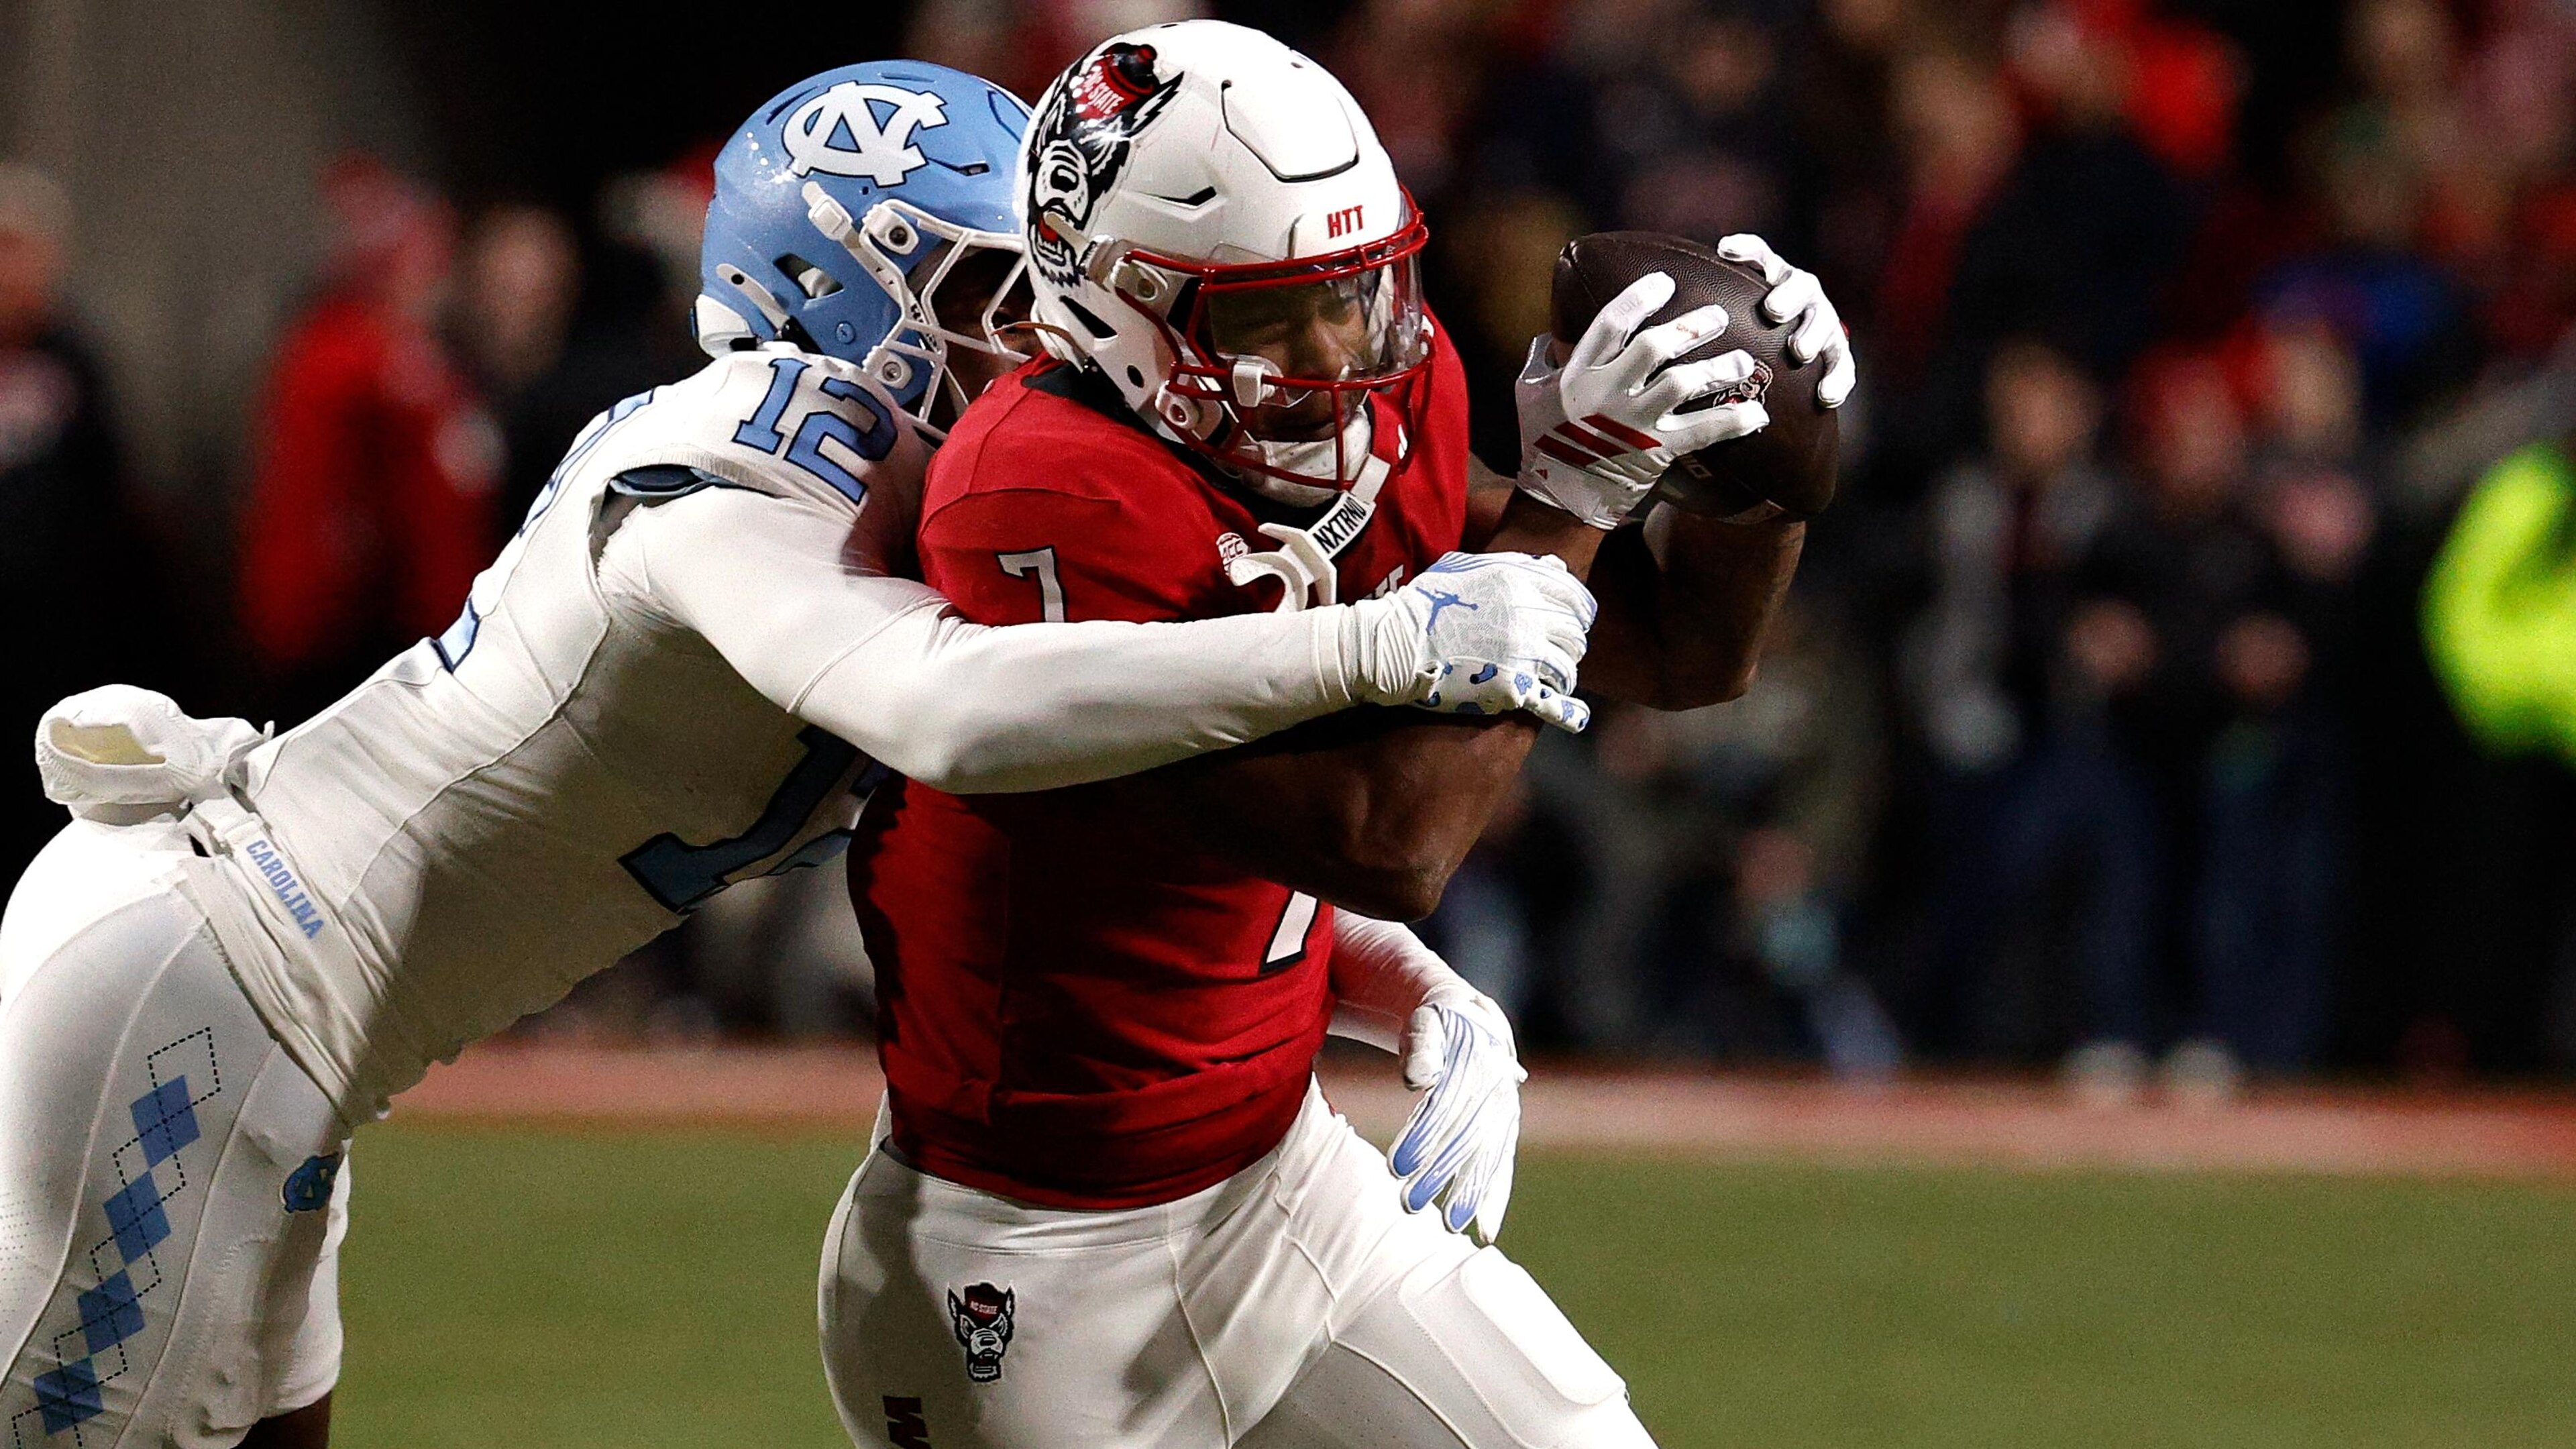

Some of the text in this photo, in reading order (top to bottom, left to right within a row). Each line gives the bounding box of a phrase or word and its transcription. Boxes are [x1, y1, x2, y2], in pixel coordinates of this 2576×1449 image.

[1087, 82, 1125, 115] STATE
[1328, 205, 1363, 239] HTT
[731, 357, 898, 506] 12
[1312, 496, 1366, 554] NXTRND
[998, 546, 1065, 623] 7
[246, 839, 325, 940] CAROLINA
